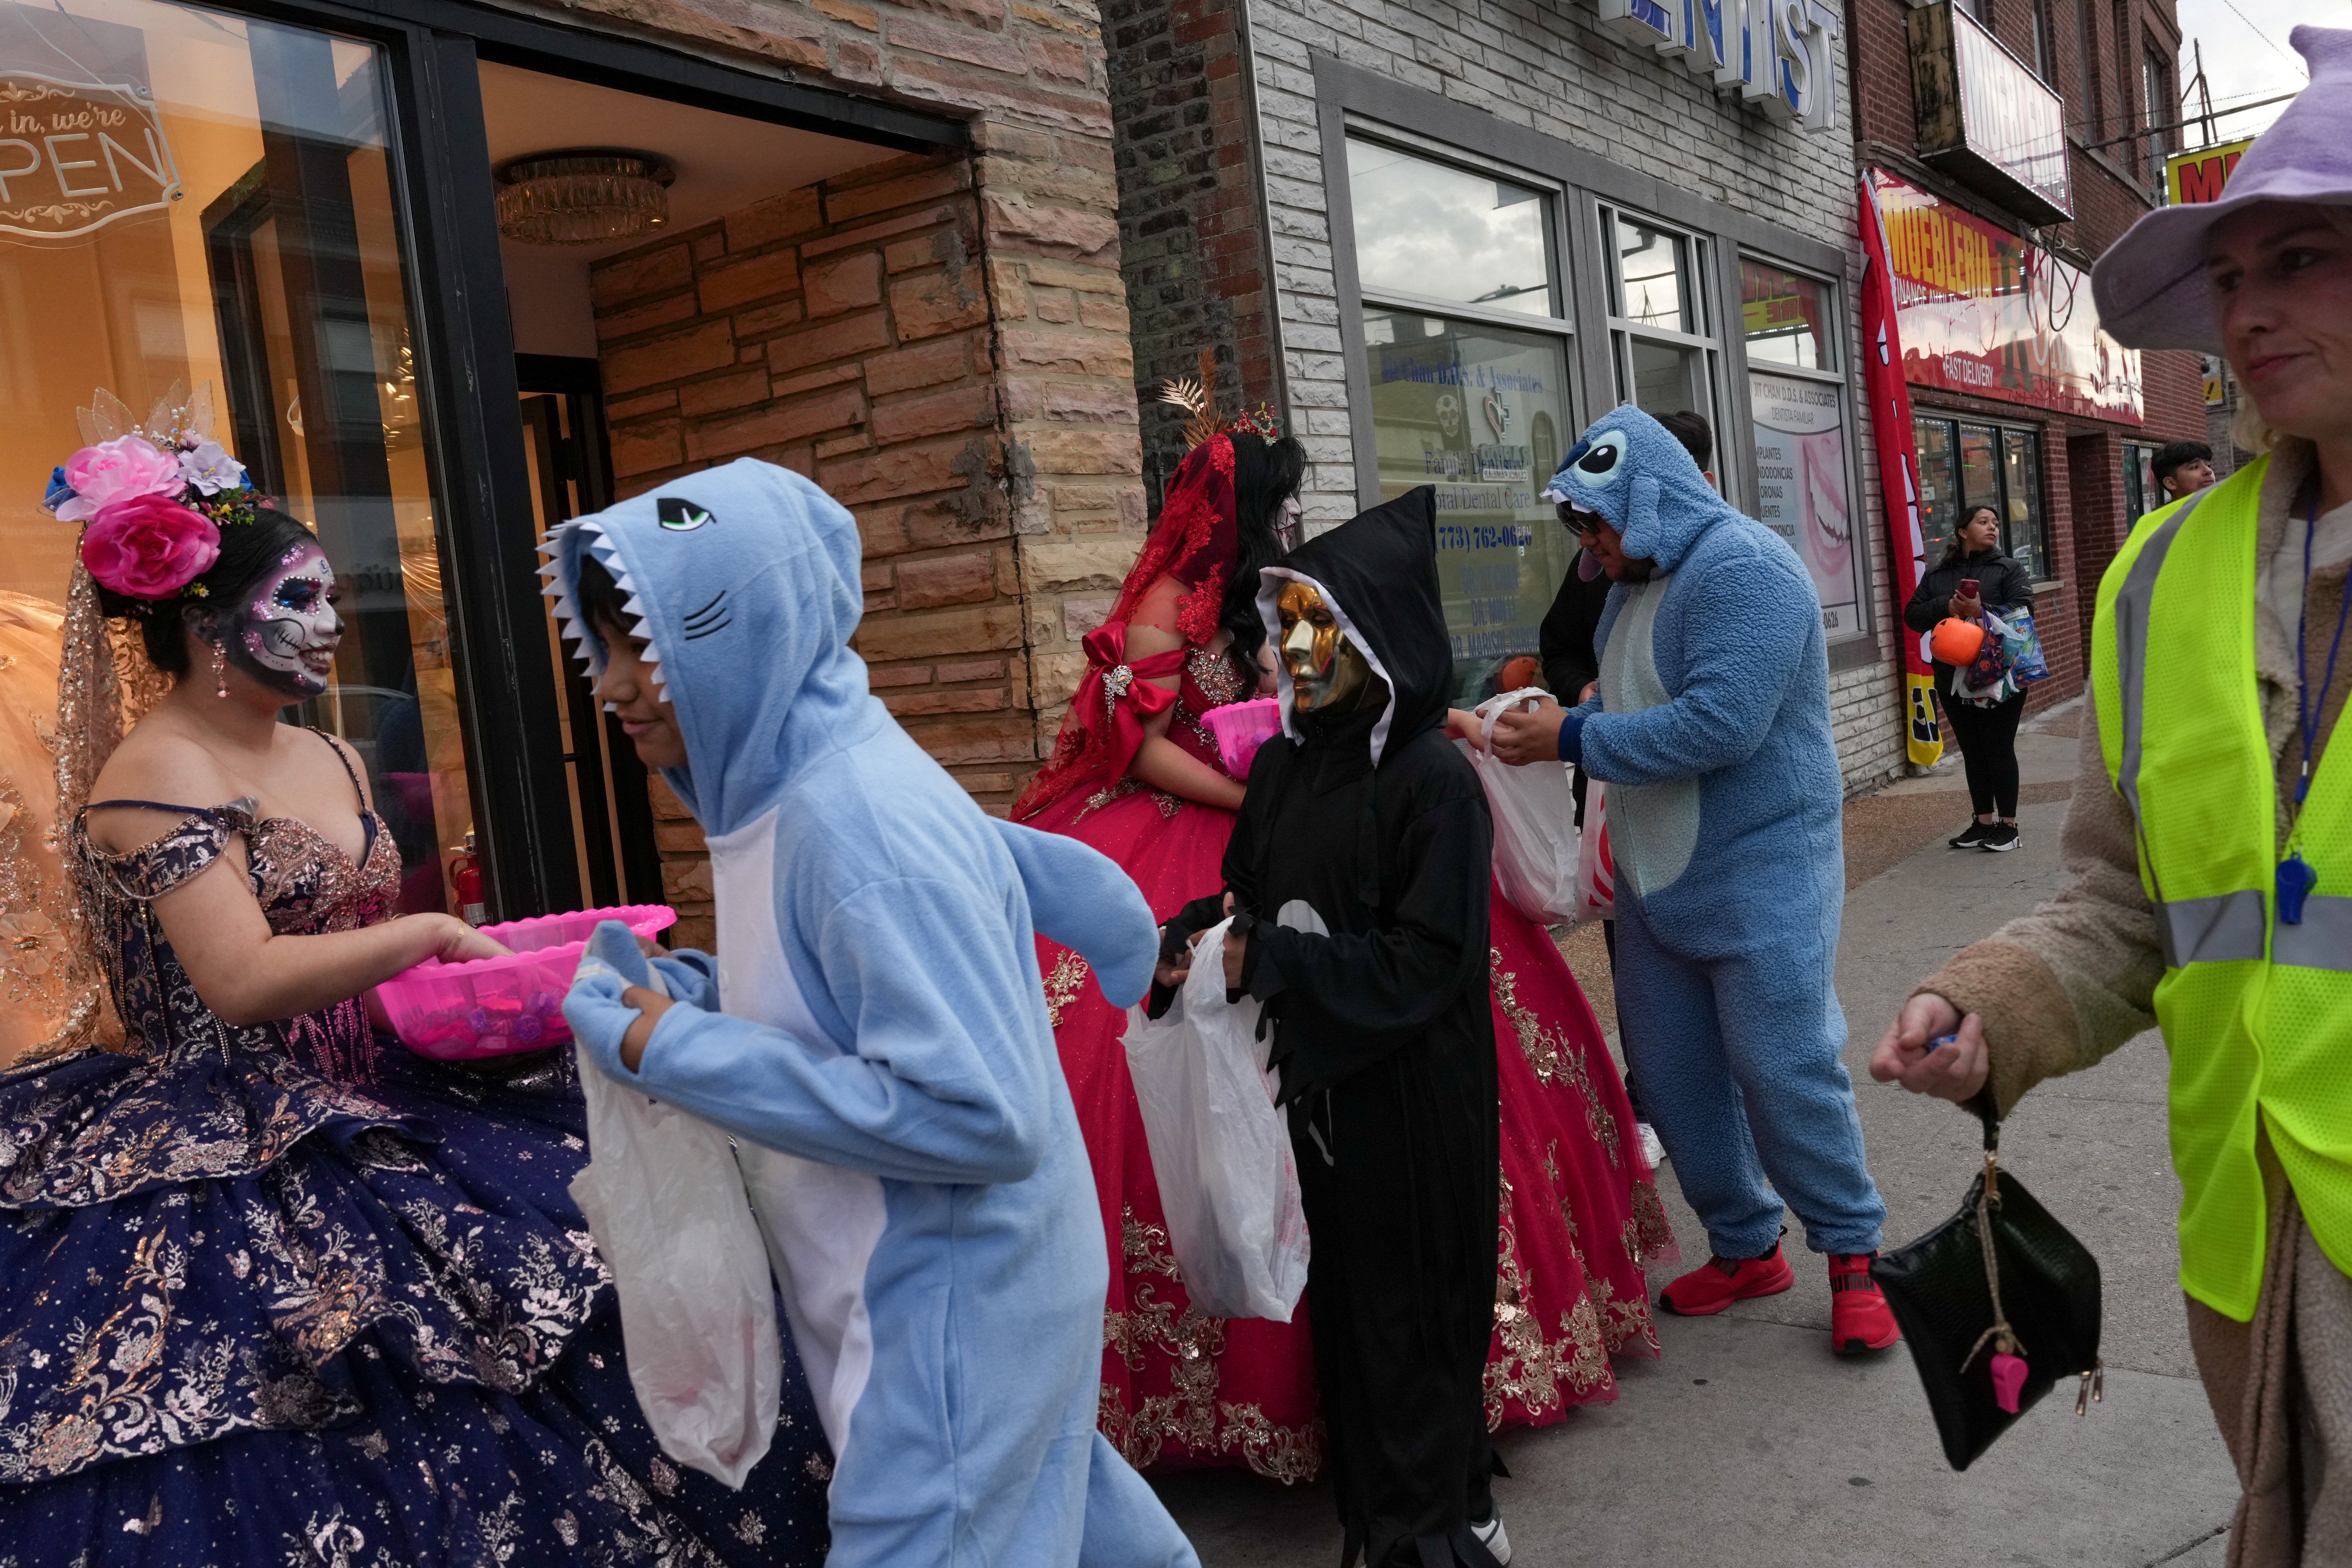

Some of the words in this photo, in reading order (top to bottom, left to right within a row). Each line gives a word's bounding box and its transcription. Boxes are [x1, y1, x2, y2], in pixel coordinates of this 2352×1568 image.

[10, 110, 45, 134] in,
[52, 101, 126, 131] we're
[1959, 19, 2066, 204] MUEBLERIA
[0, 127, 168, 204] PEN
[1880, 186, 1993, 307] MUEBLERIA
[1895, 276, 1926, 311] INANCE
[1929, 288, 1967, 323] AVAILABLE
[1490, 366, 1543, 394] Associates
[1945, 355, 1962, 382] FAST
[1963, 359, 1994, 388] DELIVERY
[1763, 383, 1781, 400] CHAN
[1782, 386, 1798, 403] D.D.S.
[1799, 389, 1804, 404] &
[1804, 390, 1836, 408] ASSOCIATES
[1771, 407, 1793, 422] DENTISTA
[1794, 410, 1814, 425] FAMILIAR
[1424, 451, 1467, 481] Family
[1471, 452, 1524, 479] Dentistry
[1756, 446, 1781, 461] MPLANTES
[1757, 466, 1793, 480] NDODONCIAS
[1435, 487, 1459, 510] otal
[1461, 487, 1502, 510] Dental
[1505, 487, 1531, 509] Care
[1759, 485, 1783, 499] ORONAS
[1761, 505, 1780, 518] UENTES
[1764, 524, 1795, 537] ODONCIA
